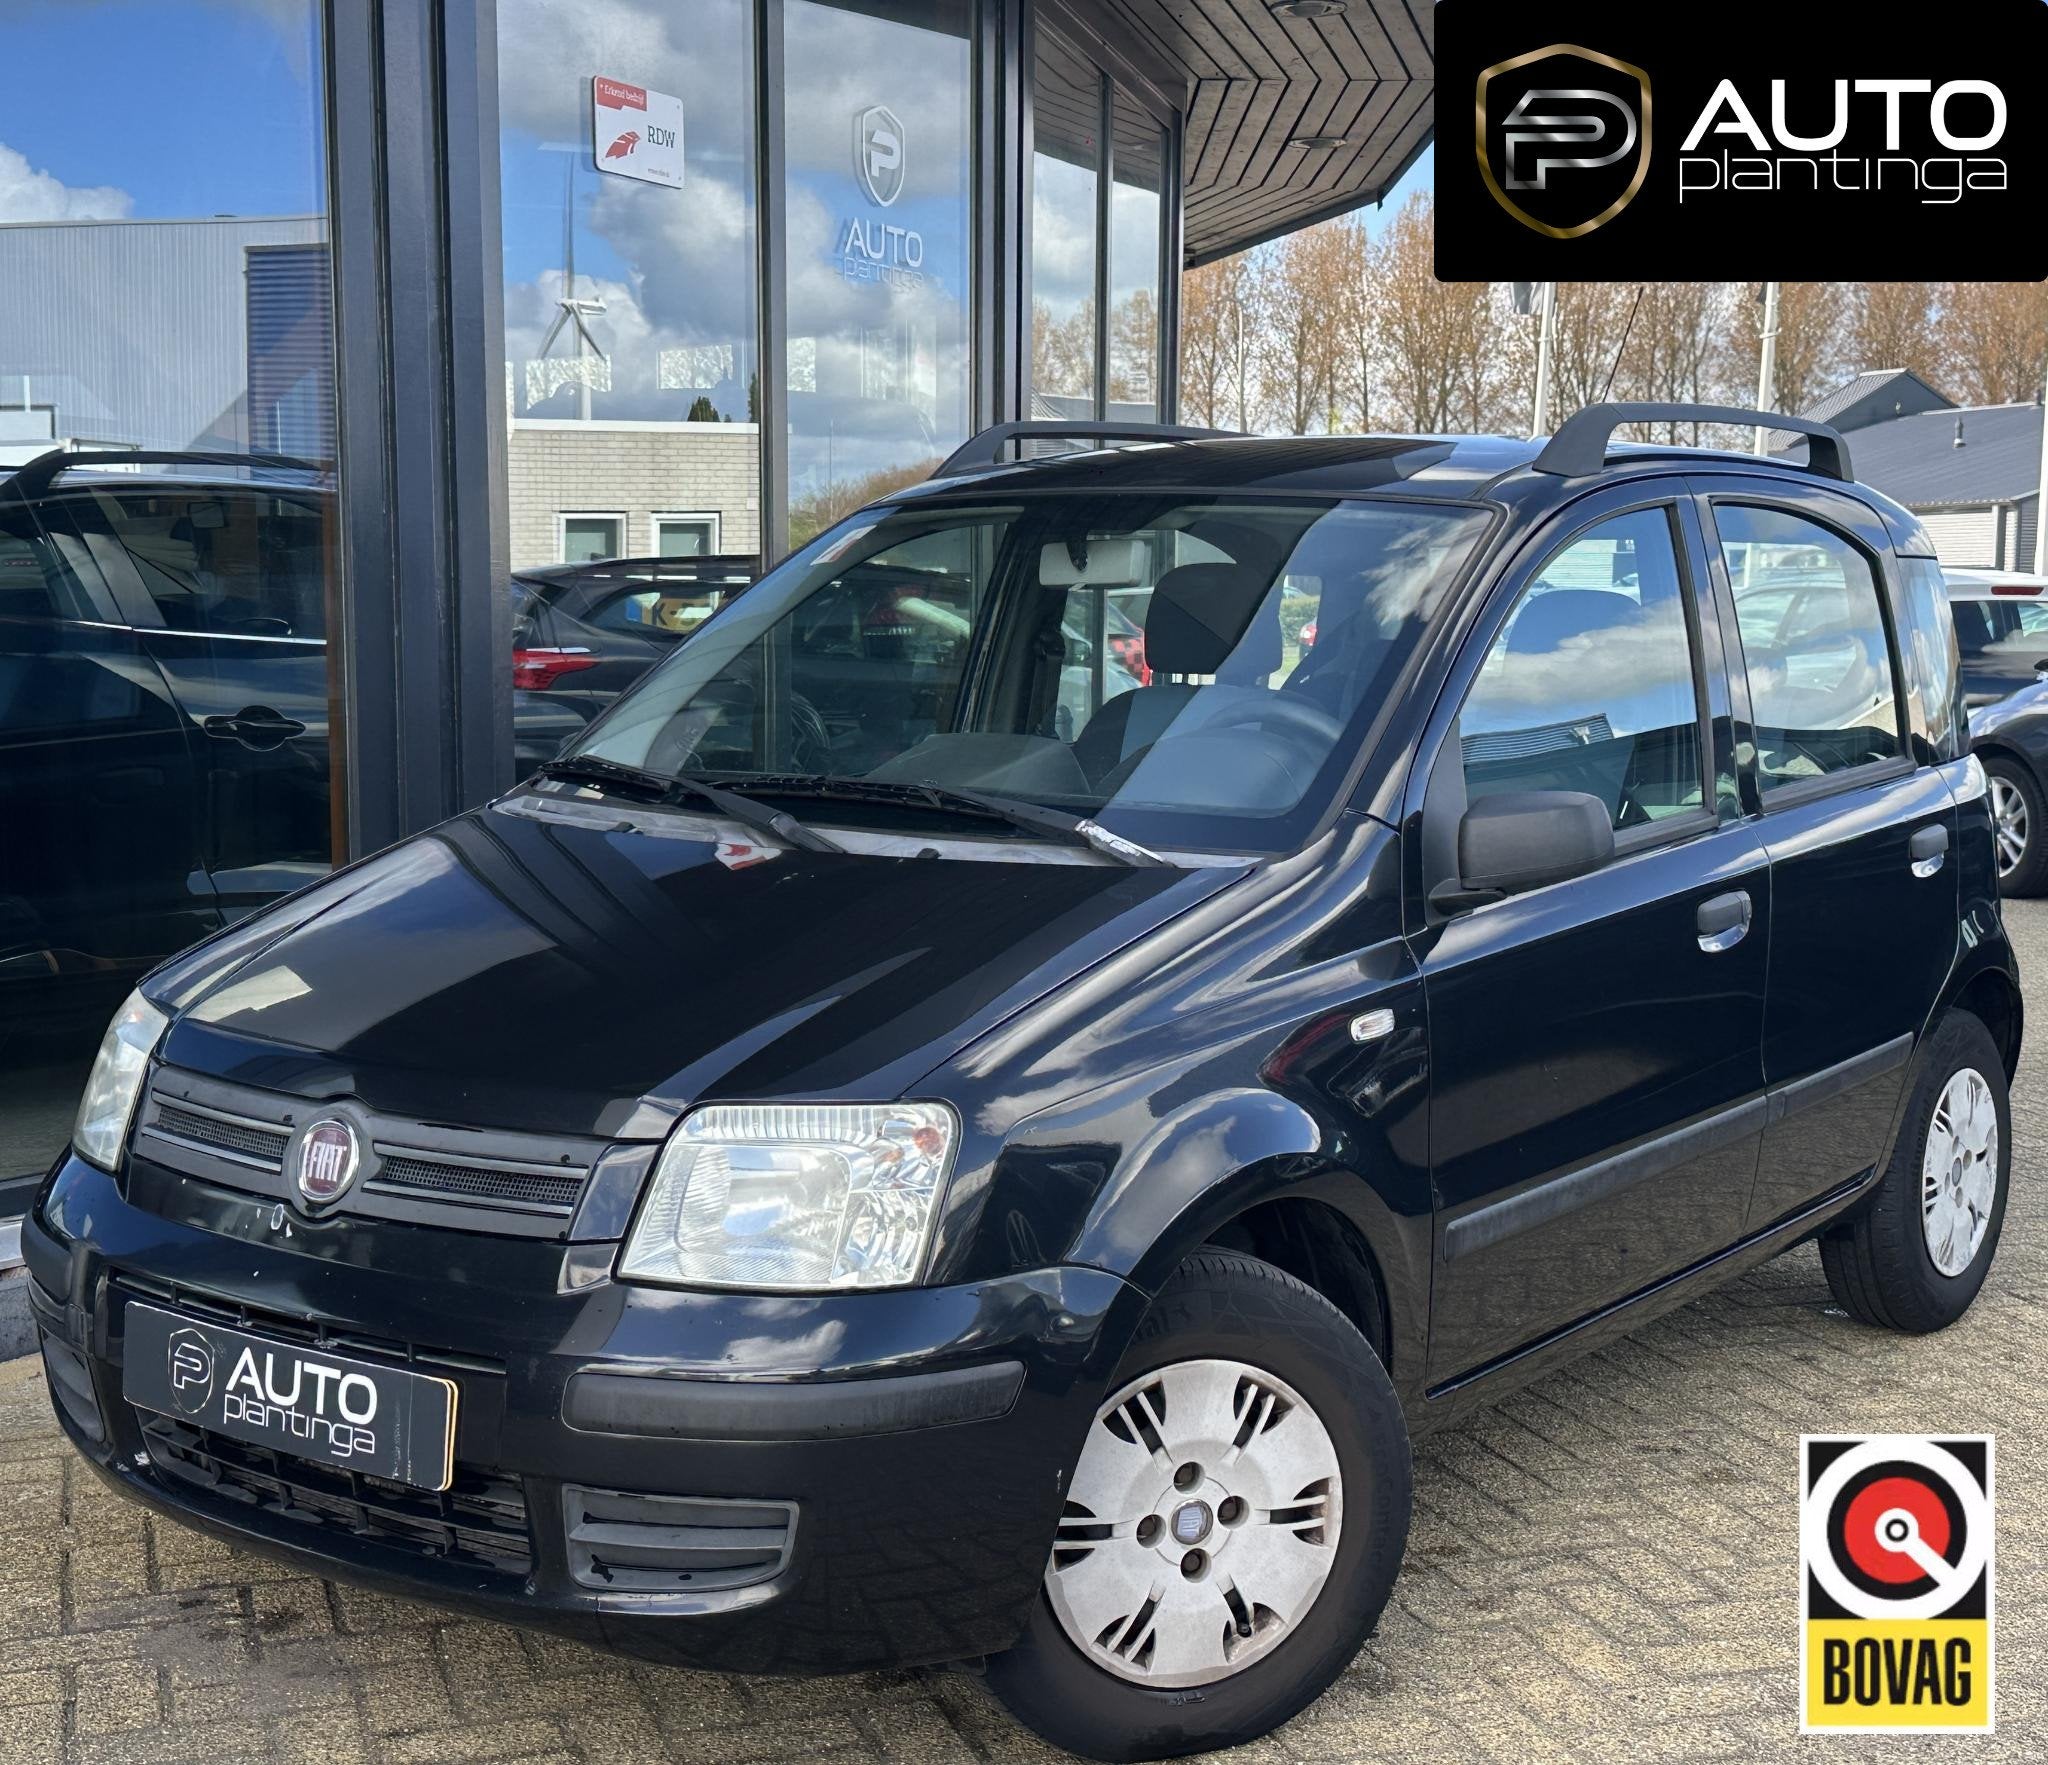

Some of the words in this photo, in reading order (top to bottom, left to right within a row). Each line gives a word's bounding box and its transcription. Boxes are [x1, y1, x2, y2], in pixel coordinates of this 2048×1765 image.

[647, 124, 675, 148] RDW
[844, 216, 923, 267] AUTO
[307, 1141, 348, 1182] FIAT
[226, 1347, 378, 1426] AUTO
[223, 1393, 376, 1458] plantinga
